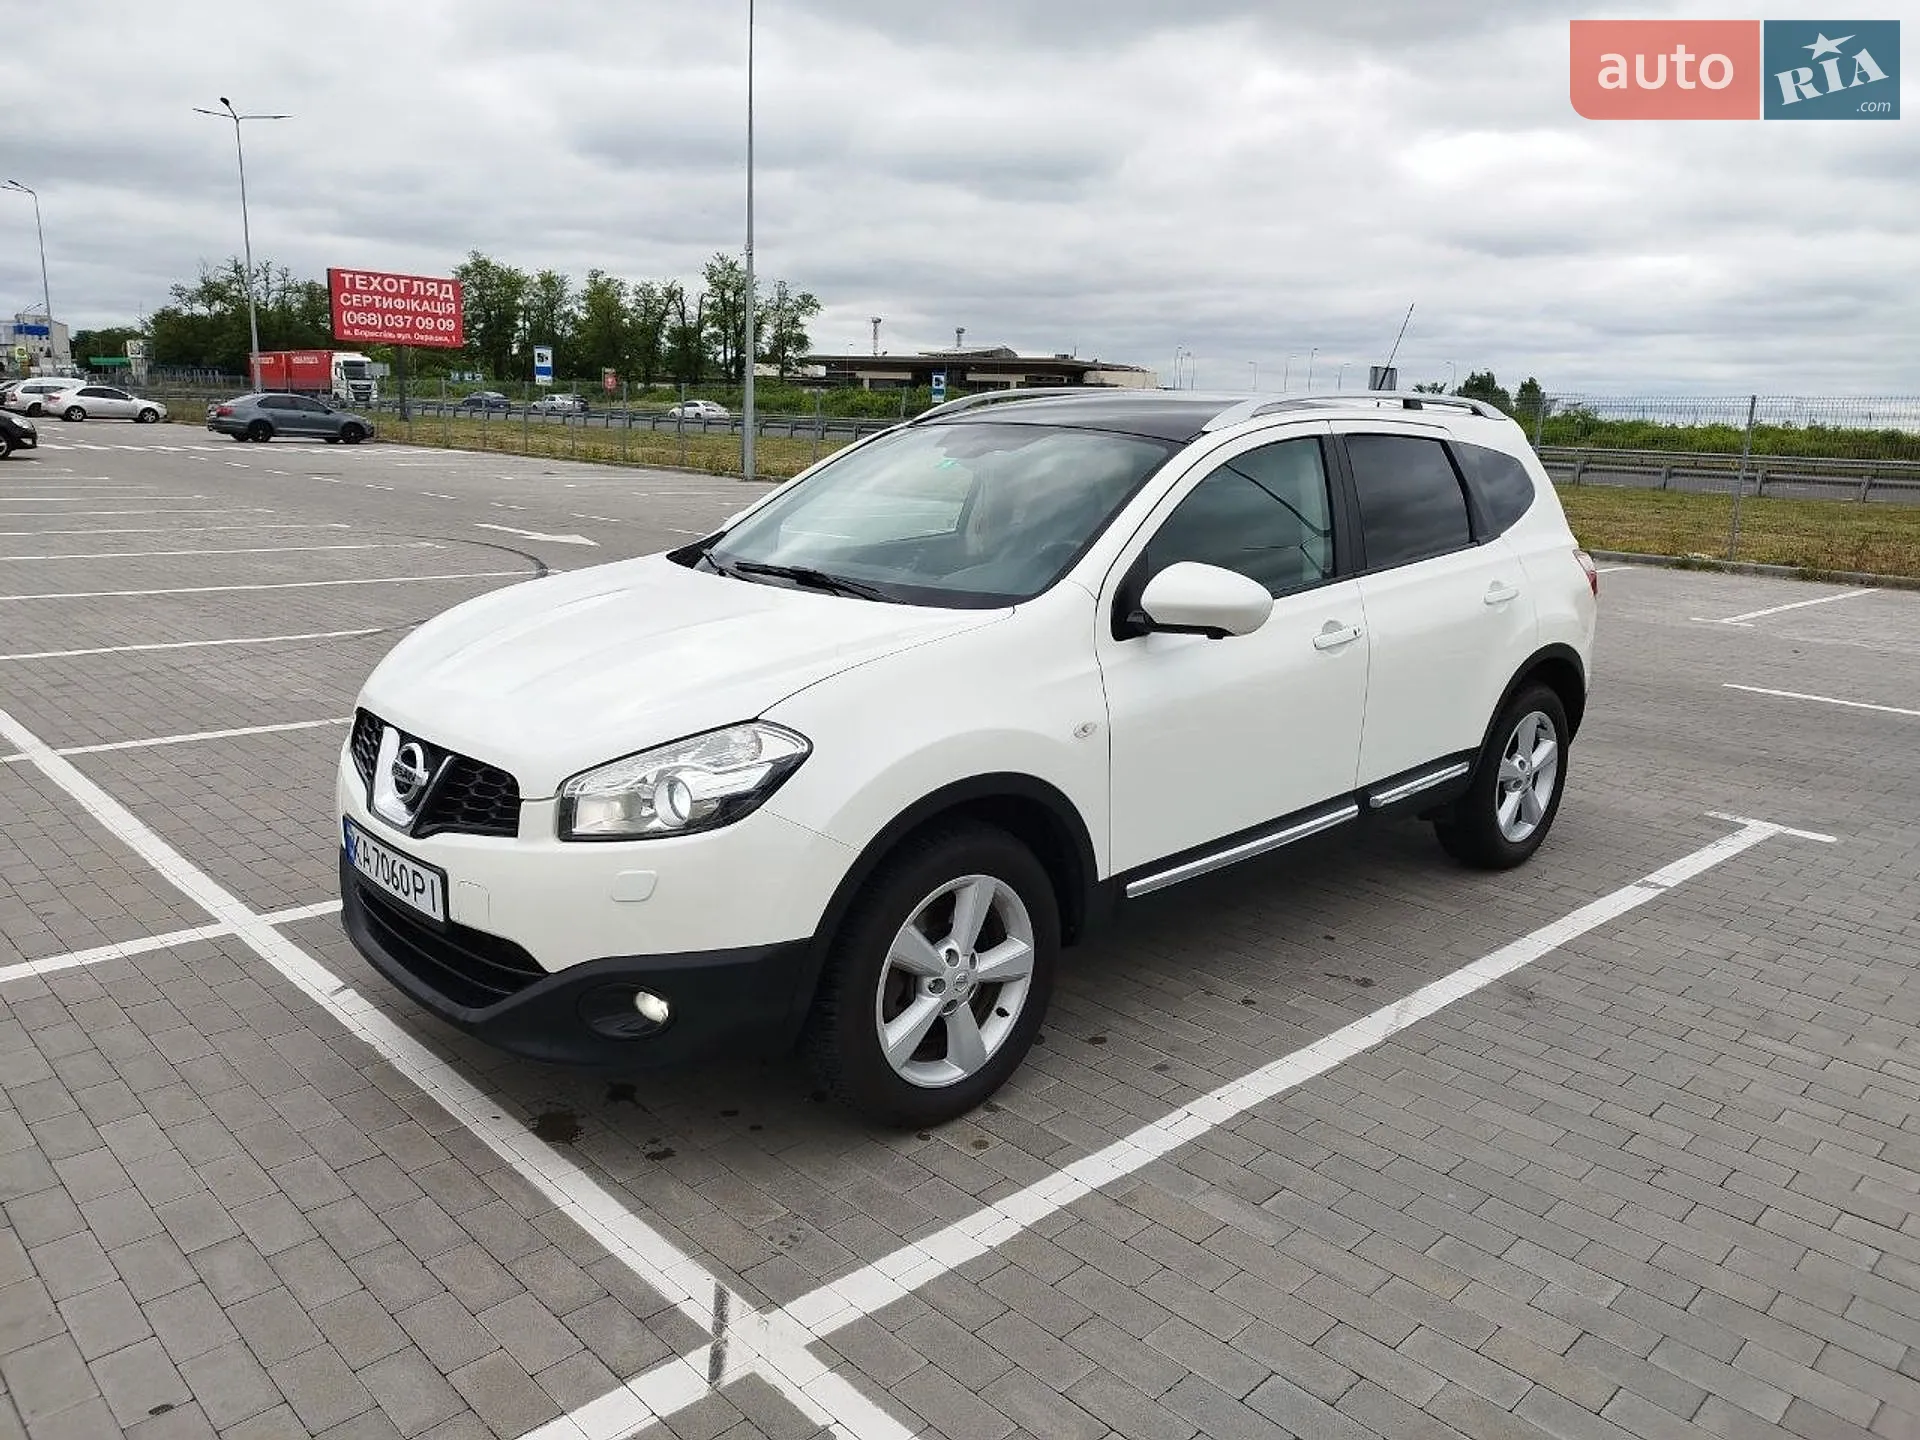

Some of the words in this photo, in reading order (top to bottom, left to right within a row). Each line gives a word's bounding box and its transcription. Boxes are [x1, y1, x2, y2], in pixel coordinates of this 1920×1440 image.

[340, 273, 455, 301] ТЕХОГЛЯД
[340, 292, 456, 315] СЕРТИФІКАЦІЯ
[342, 310, 382, 329] (068)
[384, 313, 413, 328] 037
[416, 316, 435, 330] 09
[437, 318, 456, 331] 09
